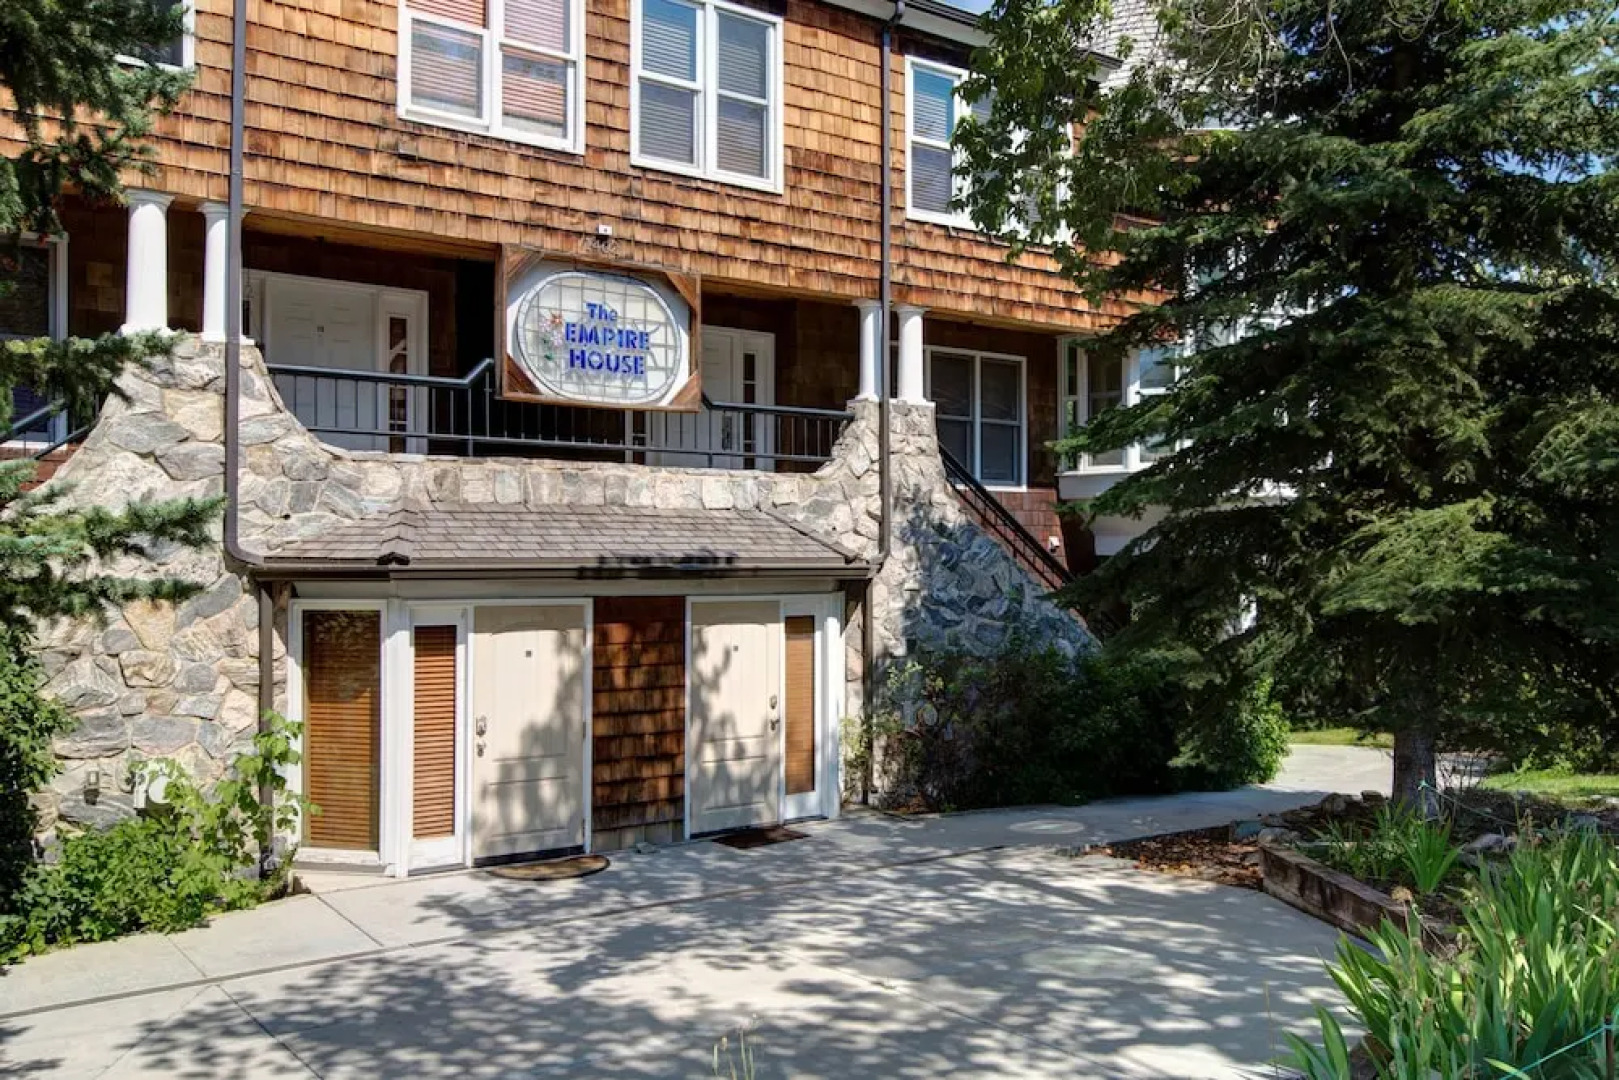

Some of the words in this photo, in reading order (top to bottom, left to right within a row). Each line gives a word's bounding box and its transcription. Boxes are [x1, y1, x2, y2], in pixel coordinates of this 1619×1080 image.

[586, 302, 618, 322] The
[565, 322, 649, 350] EMPIRE
[569, 349, 644, 375] HOUSE
